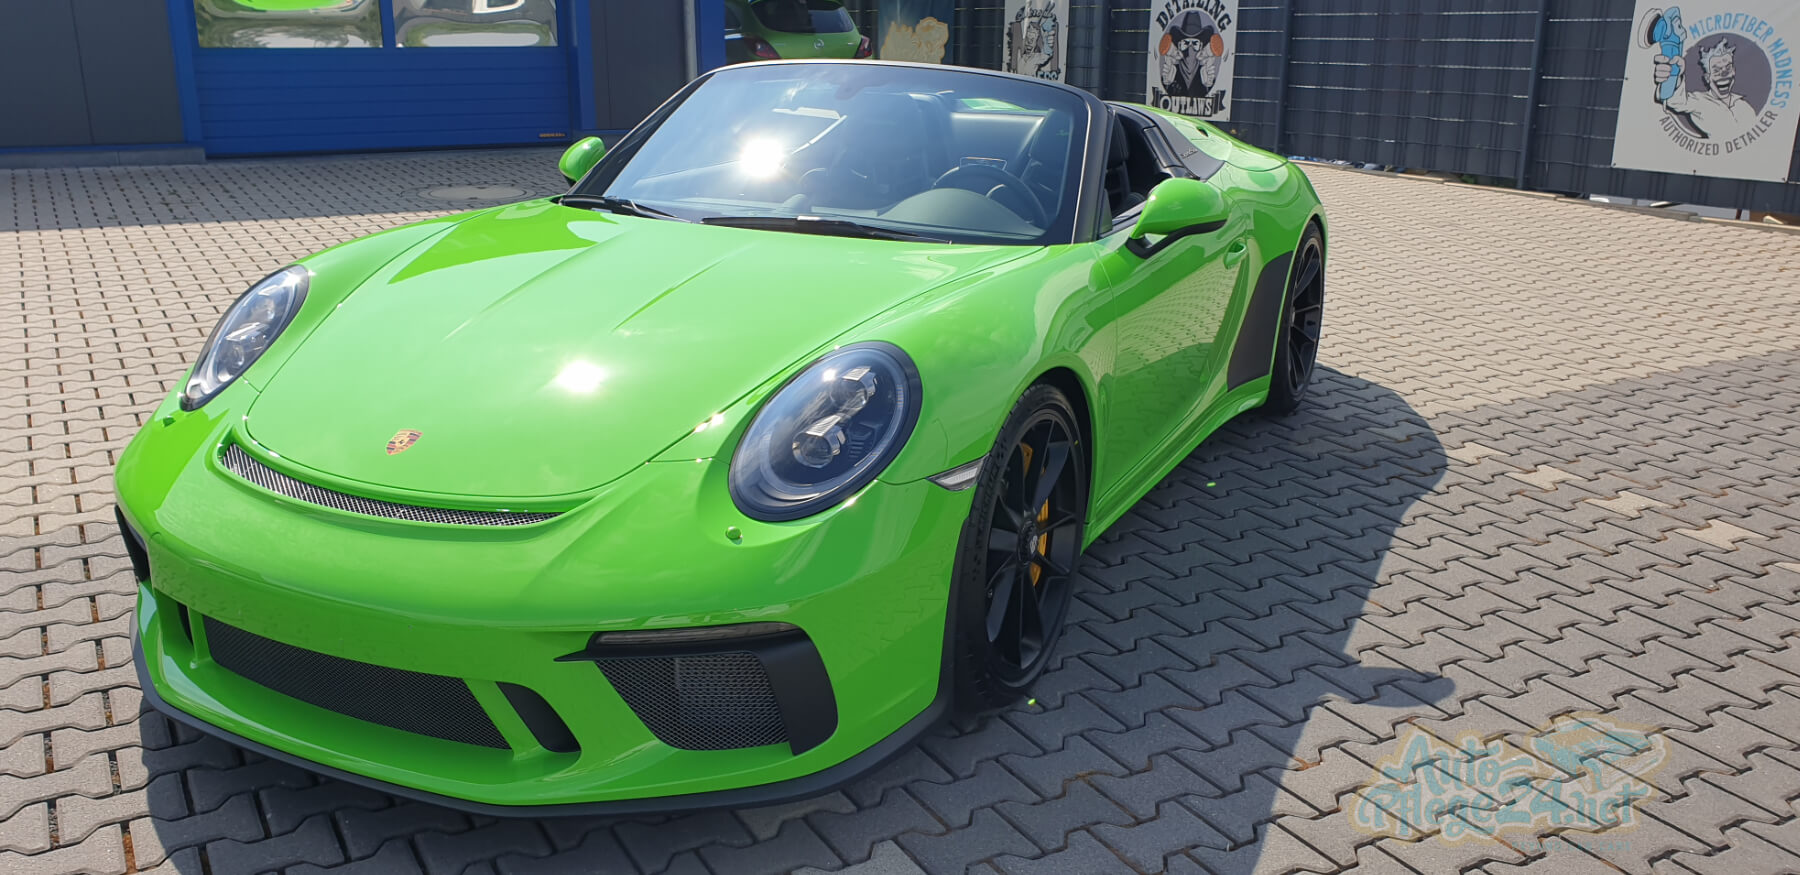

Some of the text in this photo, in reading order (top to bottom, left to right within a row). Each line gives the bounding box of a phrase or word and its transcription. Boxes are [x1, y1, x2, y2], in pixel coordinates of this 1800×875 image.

[1689, 12, 1793, 109] MICROFIBER MADNESS
[1160, 95, 1213, 116] OUTLAWS
[1659, 110, 1778, 156] AUTHORIZED DETAILER
